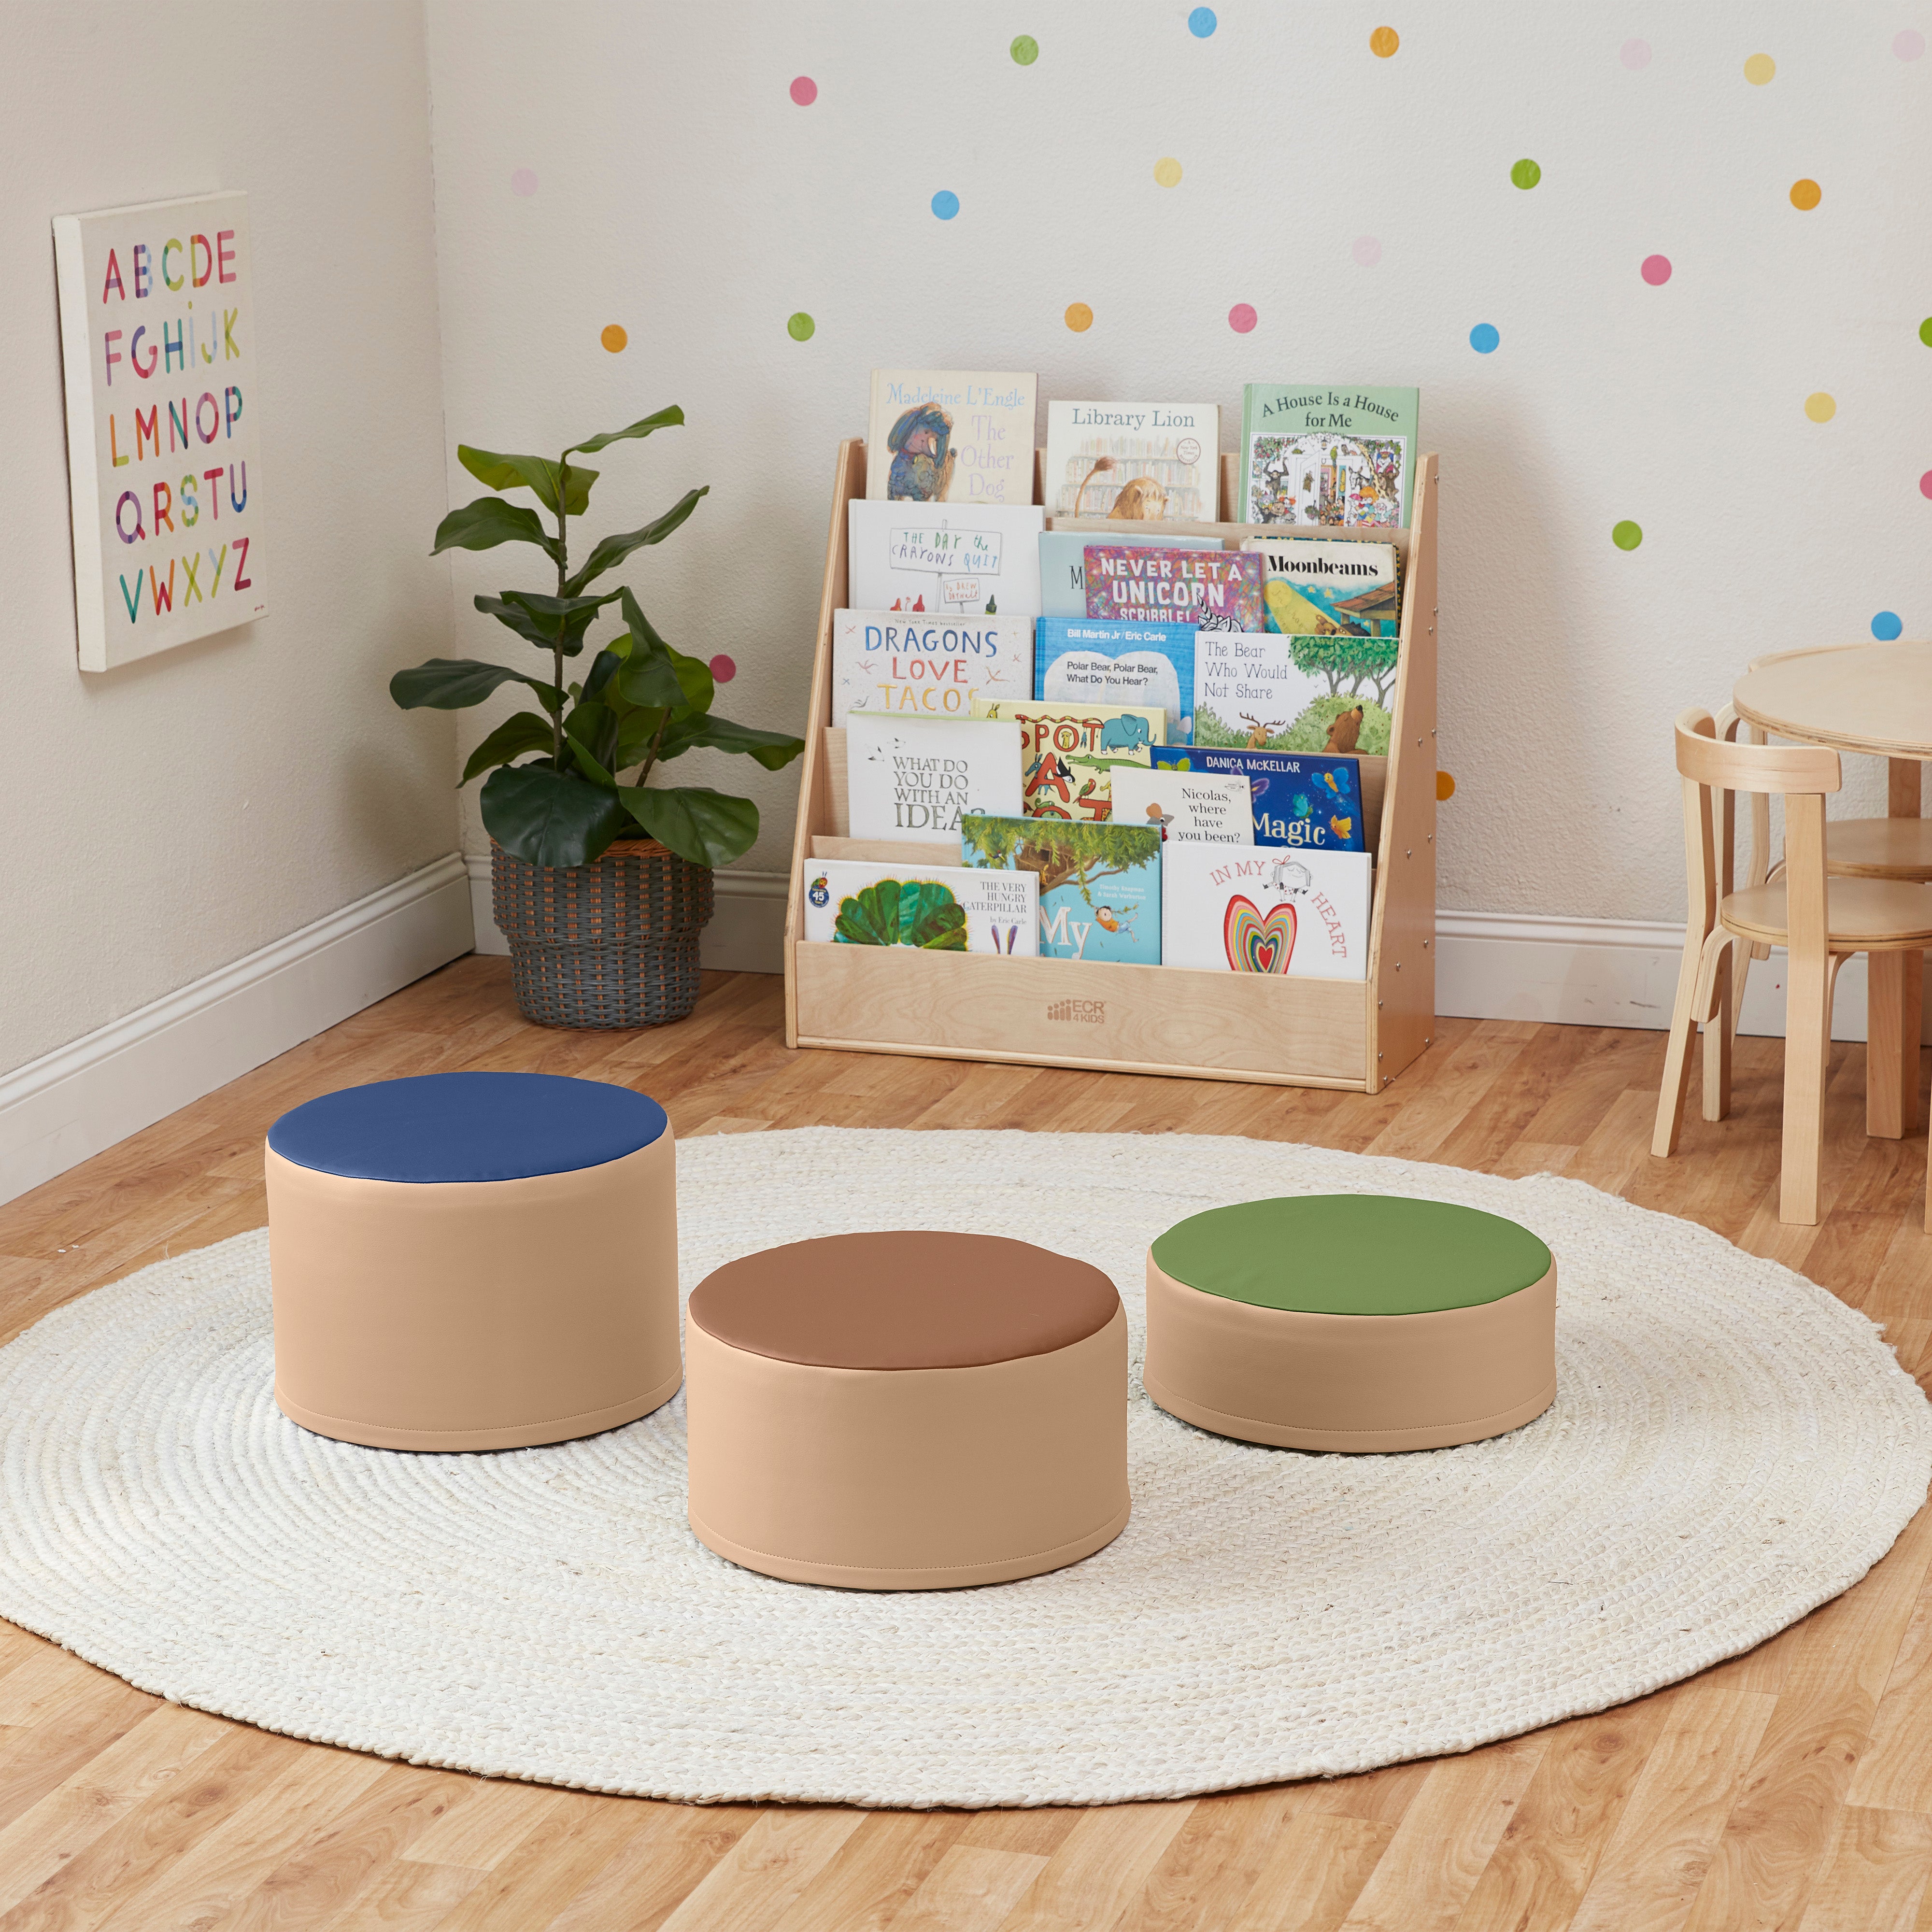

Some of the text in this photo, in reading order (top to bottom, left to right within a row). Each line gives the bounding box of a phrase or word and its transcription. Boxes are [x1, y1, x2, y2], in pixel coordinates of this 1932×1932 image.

[886, 383, 1025, 411] Madeleine L'Engle
[1262, 392, 1399, 422] A House Is a House
[971, 415, 1006, 441] The
[1072, 408, 1195, 431] Library Lion
[1305, 412, 1352, 427] for Me
[961, 444, 1014, 470] Other
[968, 473, 1005, 503] Dog
[904, 532, 988, 551] THE DAY the
[892, 544, 998, 572] CRAYONS QUIT
[1267, 555, 1378, 576] Moonbeams
[1100, 558, 1242, 581] NEVER LET A
[1112, 580, 1225, 608] UNICORN
[1120, 608, 1190, 623] SCRIBBLE!
[866, 626, 998, 657] DRAGONS
[1067, 628, 1081, 638] Bill
[1083, 630, 1109, 639] Martin
[1143, 632, 1166, 641] Carle
[1205, 641, 1266, 658] The Bear
[892, 656, 968, 683] LOVE
[1067, 661, 1158, 675] Polar Bear, Polar Bear,
[1205, 662, 1288, 680] Who Would
[1066, 674, 1148, 686] What Do You Hear?
[1204, 682, 1273, 699] Not Share
[893, 756, 968, 773] WHAT DO
[1206, 756, 1244, 770] DANICA
[894, 771, 969, 790] YOU DO
[894, 788, 968, 805] WITH AN
[1181, 788, 1232, 803] Nicolas,
[1188, 804, 1227, 815] where
[1193, 816, 1223, 829] have
[1252, 812, 1326, 846] Magic
[1178, 831, 1240, 843] you been?
[1209, 860, 1266, 886] IN MY
[980, 881, 1027, 893] THE VERY
[812, 891, 824, 901] 45
[987, 892, 1027, 903] HUNGRY
[963, 901, 1027, 913] CATERPILLAR
[1039, 905, 1093, 960] My
[1310, 892, 1348, 959] HEART
[1072, 999, 1105, 1014] ECR
